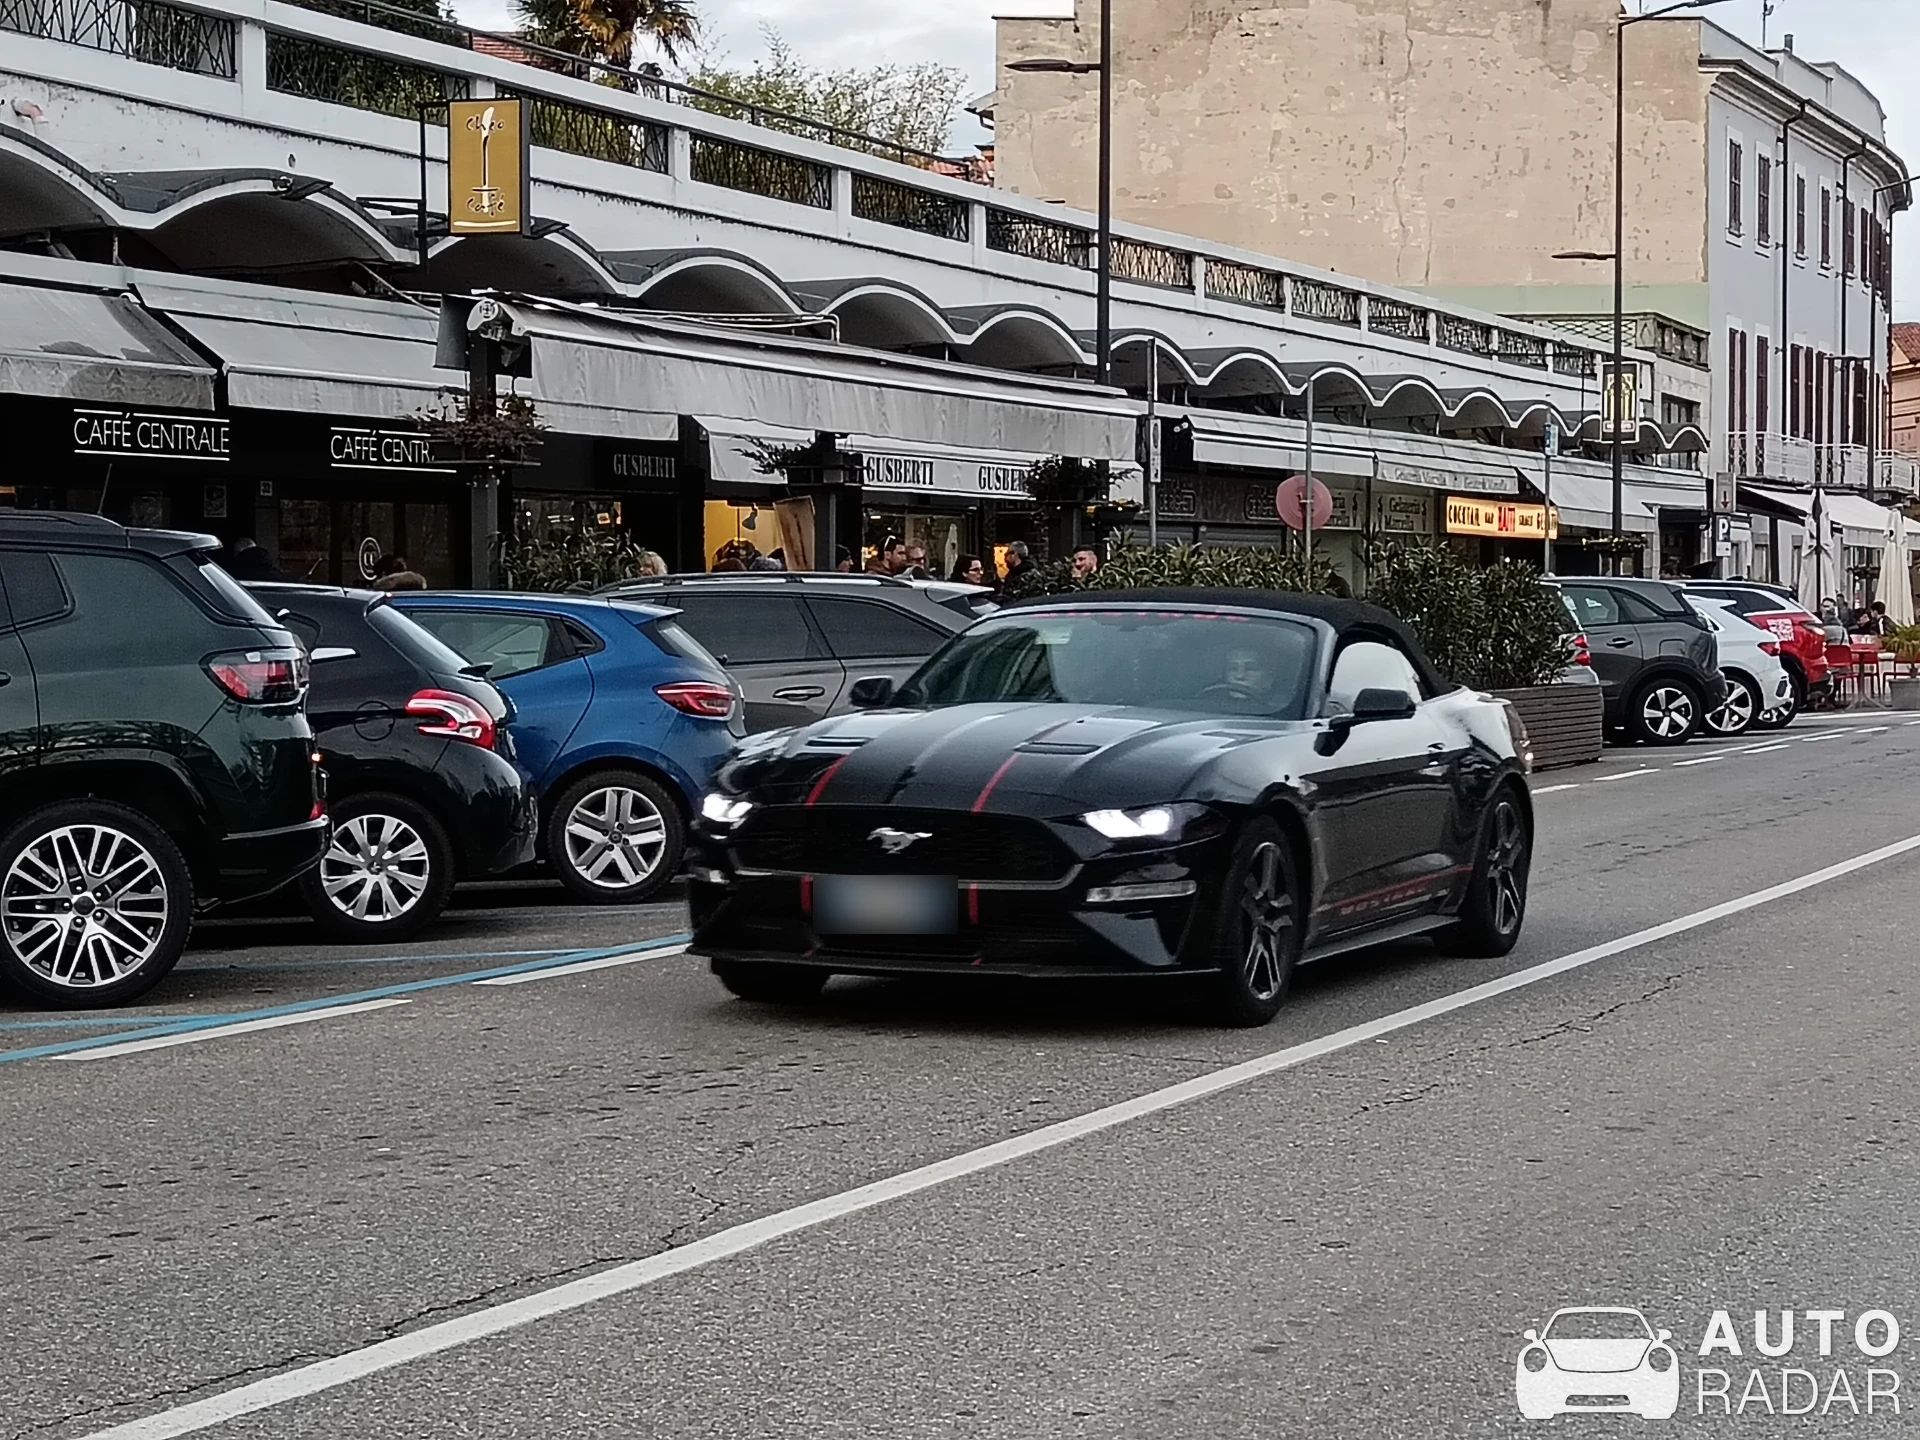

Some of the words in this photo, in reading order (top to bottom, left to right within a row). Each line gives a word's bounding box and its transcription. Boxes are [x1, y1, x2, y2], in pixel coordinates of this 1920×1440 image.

[74, 412, 131, 447] CAFFÉ
[137, 422, 230, 453] CENTRALE
[331, 430, 378, 461] CAFFÉ
[382, 438, 435, 463] CENTR
[613, 453, 676, 478] GUSBERTI
[866, 456, 934, 486] GUSBERTI
[978, 465, 1027, 492] GUSBER
